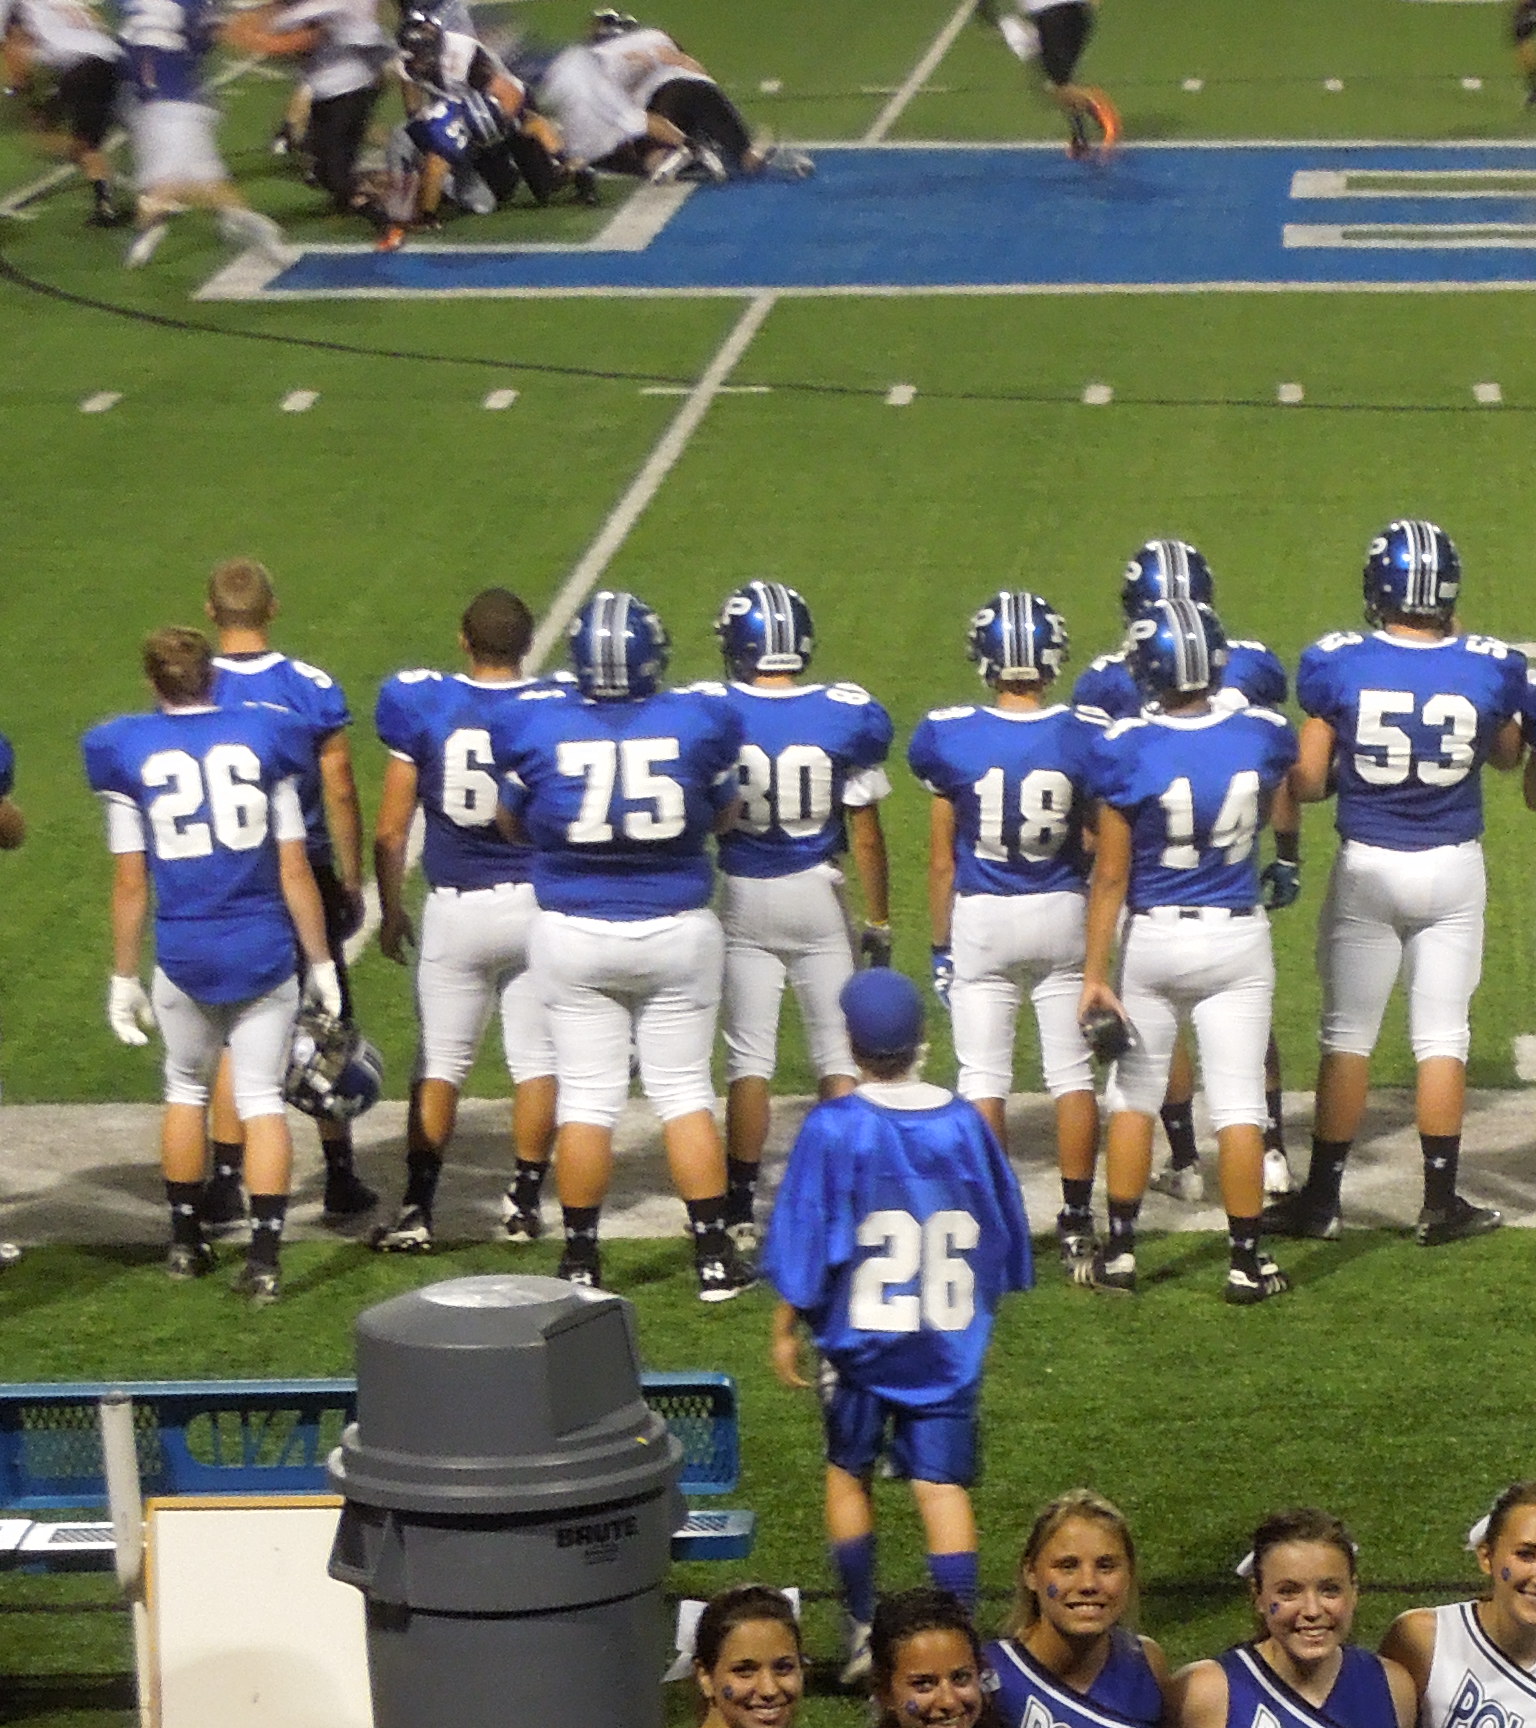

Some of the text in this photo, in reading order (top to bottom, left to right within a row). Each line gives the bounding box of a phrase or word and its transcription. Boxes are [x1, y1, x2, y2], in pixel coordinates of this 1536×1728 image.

[1354, 690, 1477, 787] 53
[141, 743, 270, 860] 26
[557, 738, 685, 843] 75
[735, 744, 832, 837] 80
[974, 767, 1072, 862] 18
[1159, 770, 1259, 869] 14
[849, 1209, 979, 1332] 26
[557, 1516, 639, 1547] BRUTE
